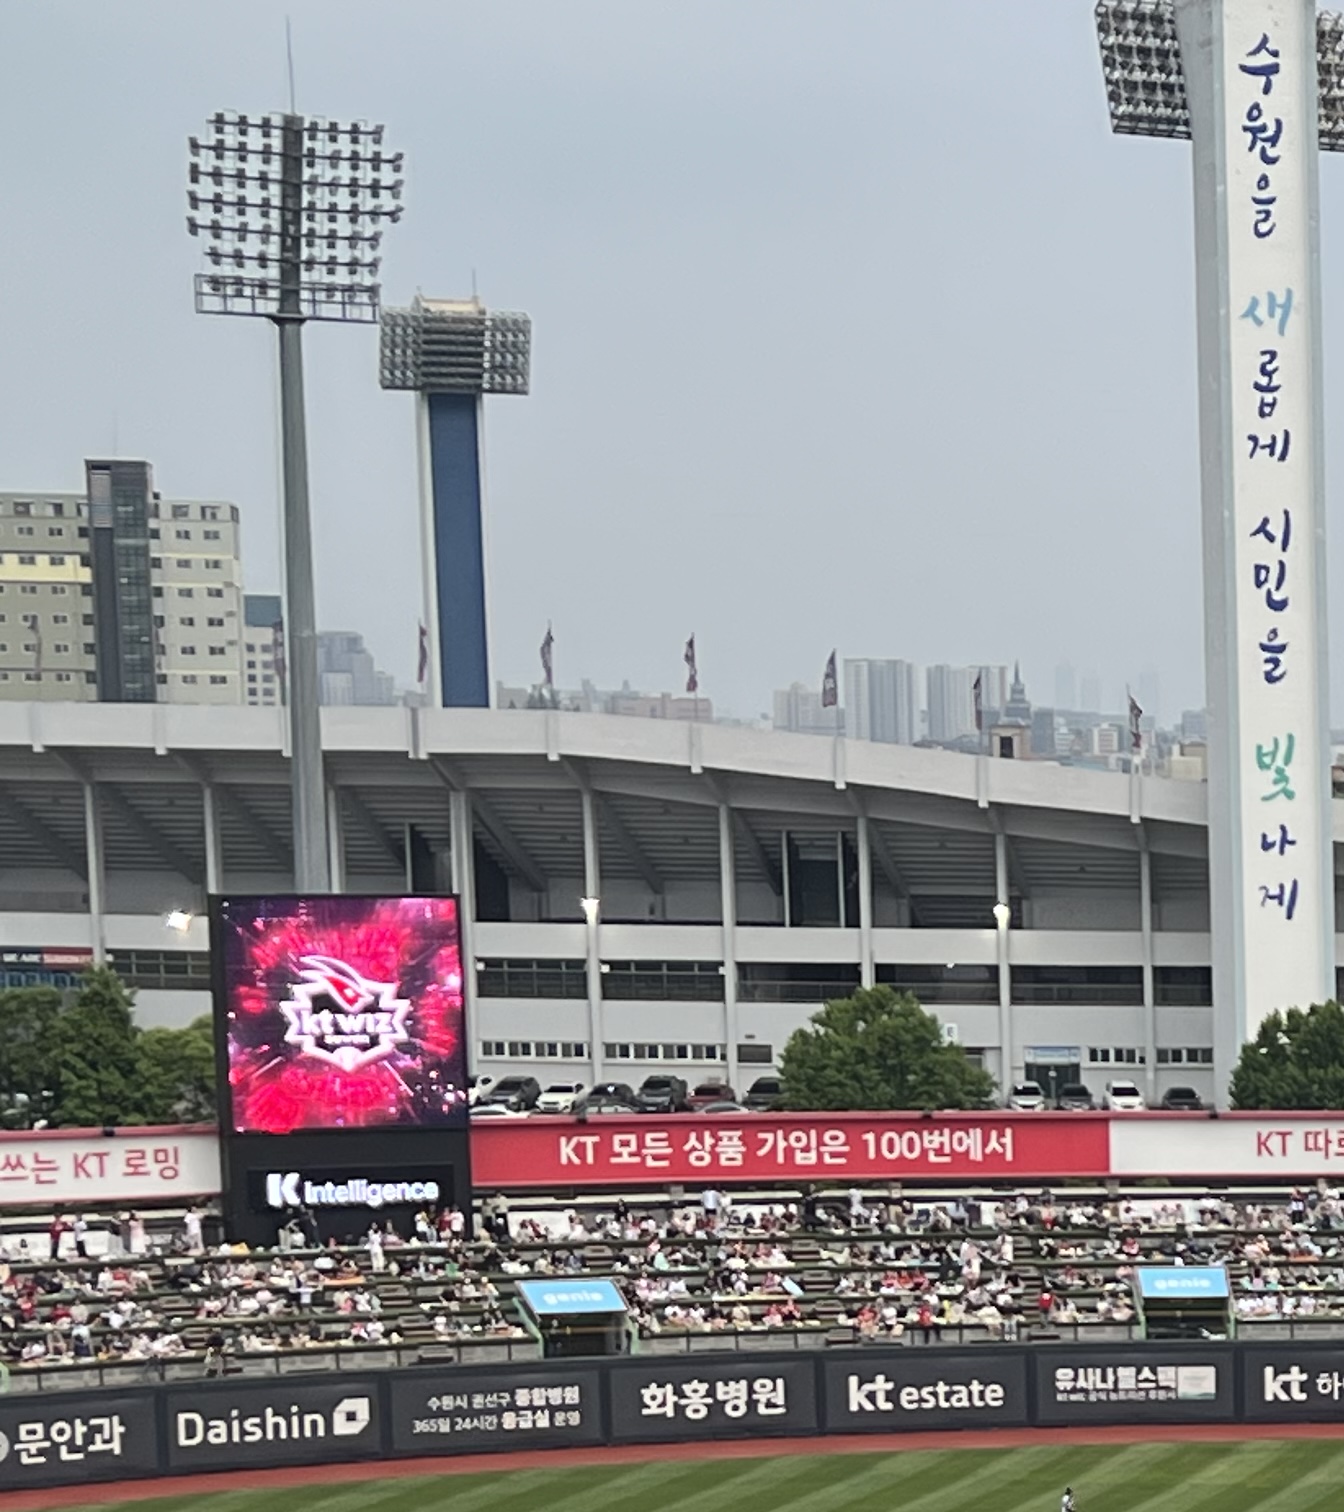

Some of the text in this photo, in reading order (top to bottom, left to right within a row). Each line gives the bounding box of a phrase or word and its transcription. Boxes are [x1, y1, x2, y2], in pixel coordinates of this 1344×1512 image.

[1238, 33, 1298, 920] 수원을 새롭게 시민을 빛나게
[301, 1009, 393, 1036] kt wiz
[558, 1126, 1015, 1168] KT 모든 상품 가입은 100번에서
[1255, 1129, 1293, 1158] KT
[0, 1146, 180, 1185] 쓰는 KT 로밍
[266, 1172, 440, 1209] K intelligence
[640, 1377, 788, 1421] 화홍병원
[847, 1373, 1005, 1413] kt estate
[1263, 1365, 1309, 1402] kt
[13, 1414, 127, 1466] 문안과
[176, 1404, 327, 1448] Daishin
[411, 1409, 582, 1434] 365일 24시간 응급실 운영
